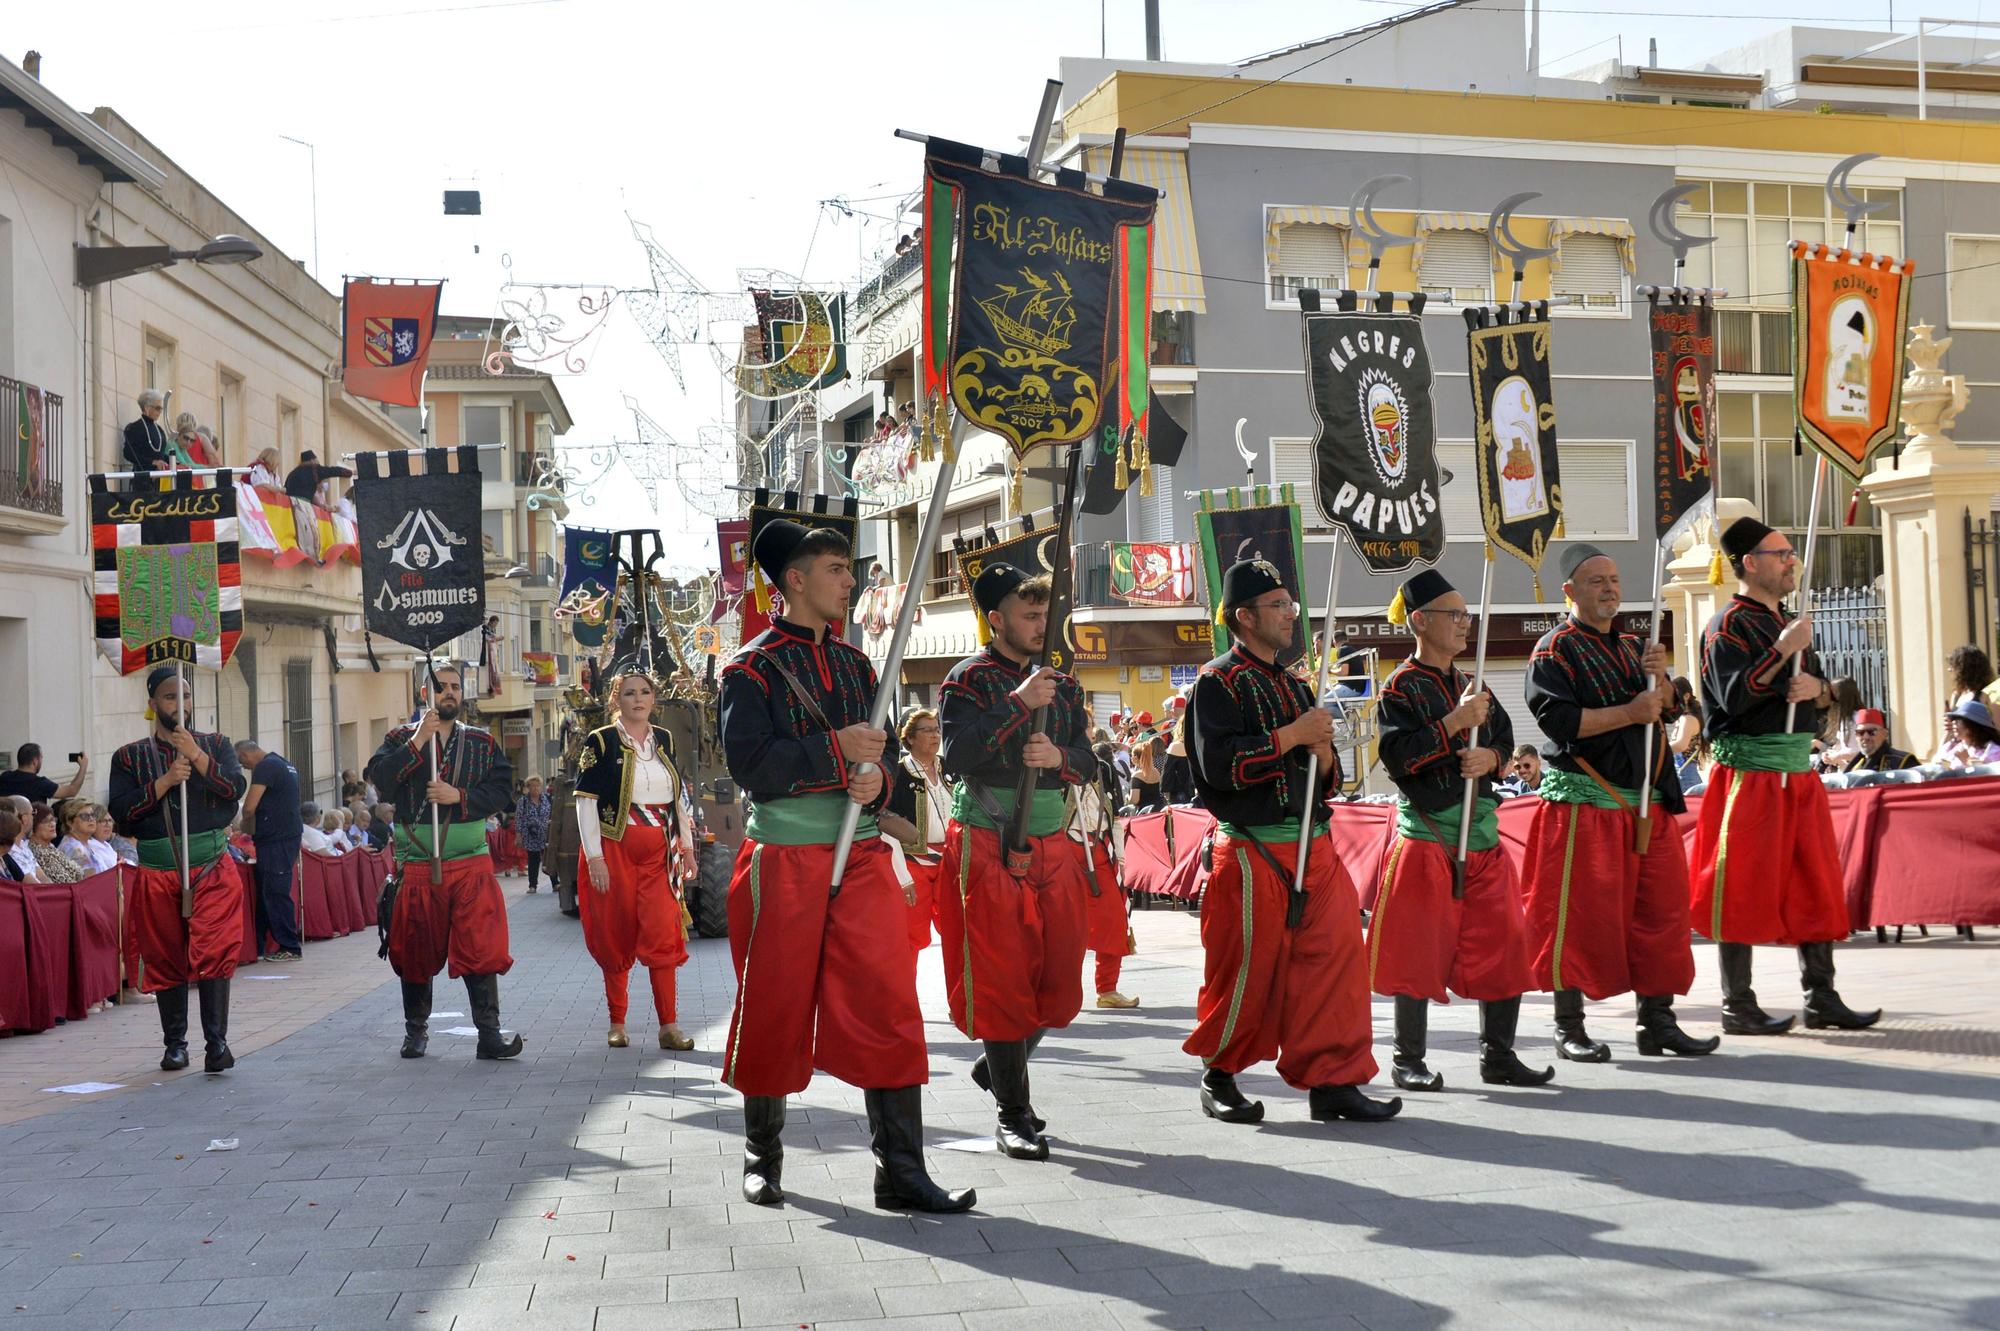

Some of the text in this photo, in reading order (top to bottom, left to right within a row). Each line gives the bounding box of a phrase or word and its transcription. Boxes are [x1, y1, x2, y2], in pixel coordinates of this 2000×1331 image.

[1329, 330, 1416, 373] NEGRES
[1010, 414, 1043, 429] 2007
[1332, 479, 1437, 535] PAPUES
[407, 611, 444, 627] 2009
[151, 640, 191, 661] 1990
